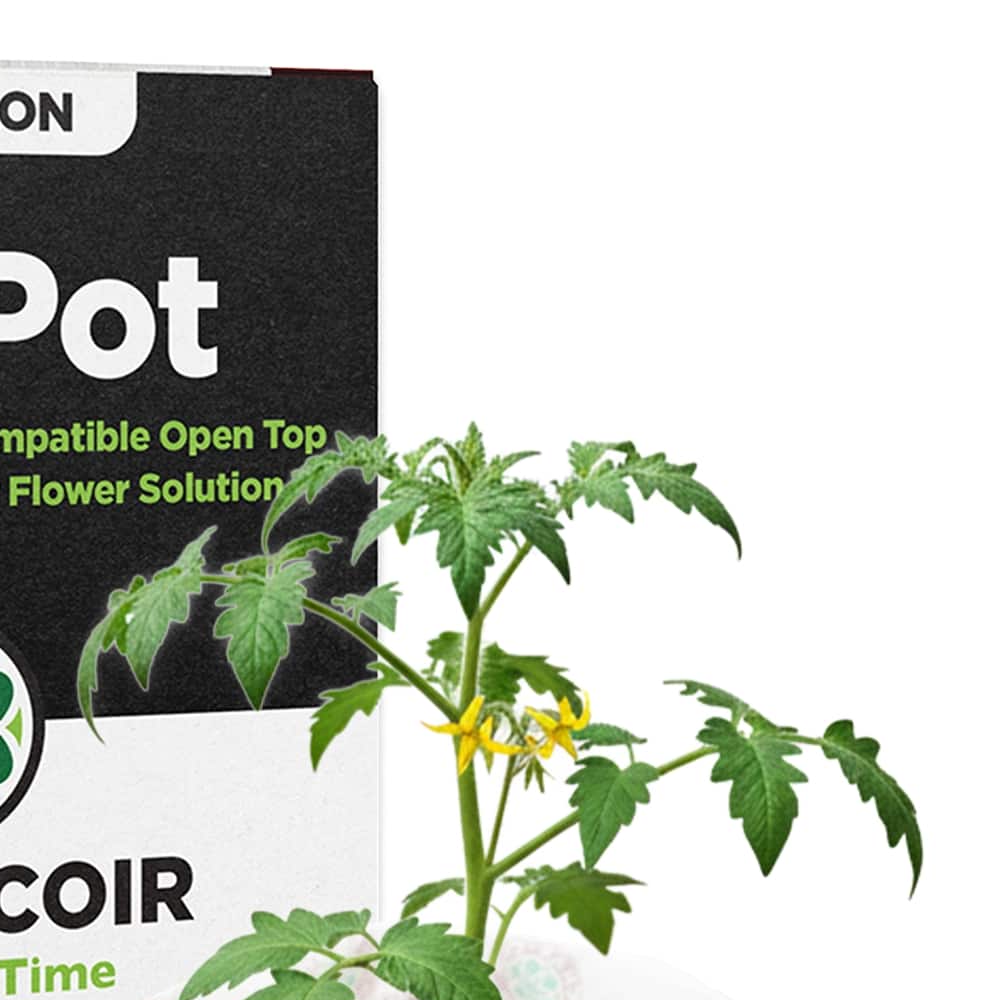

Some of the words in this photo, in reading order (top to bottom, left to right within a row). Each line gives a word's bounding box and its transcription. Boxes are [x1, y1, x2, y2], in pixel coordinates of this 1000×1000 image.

[159, 420, 254, 457] Open
[262, 419, 327, 455] Top
[9, 474, 131, 507] Flower
[138, 470, 284, 503] Solution
